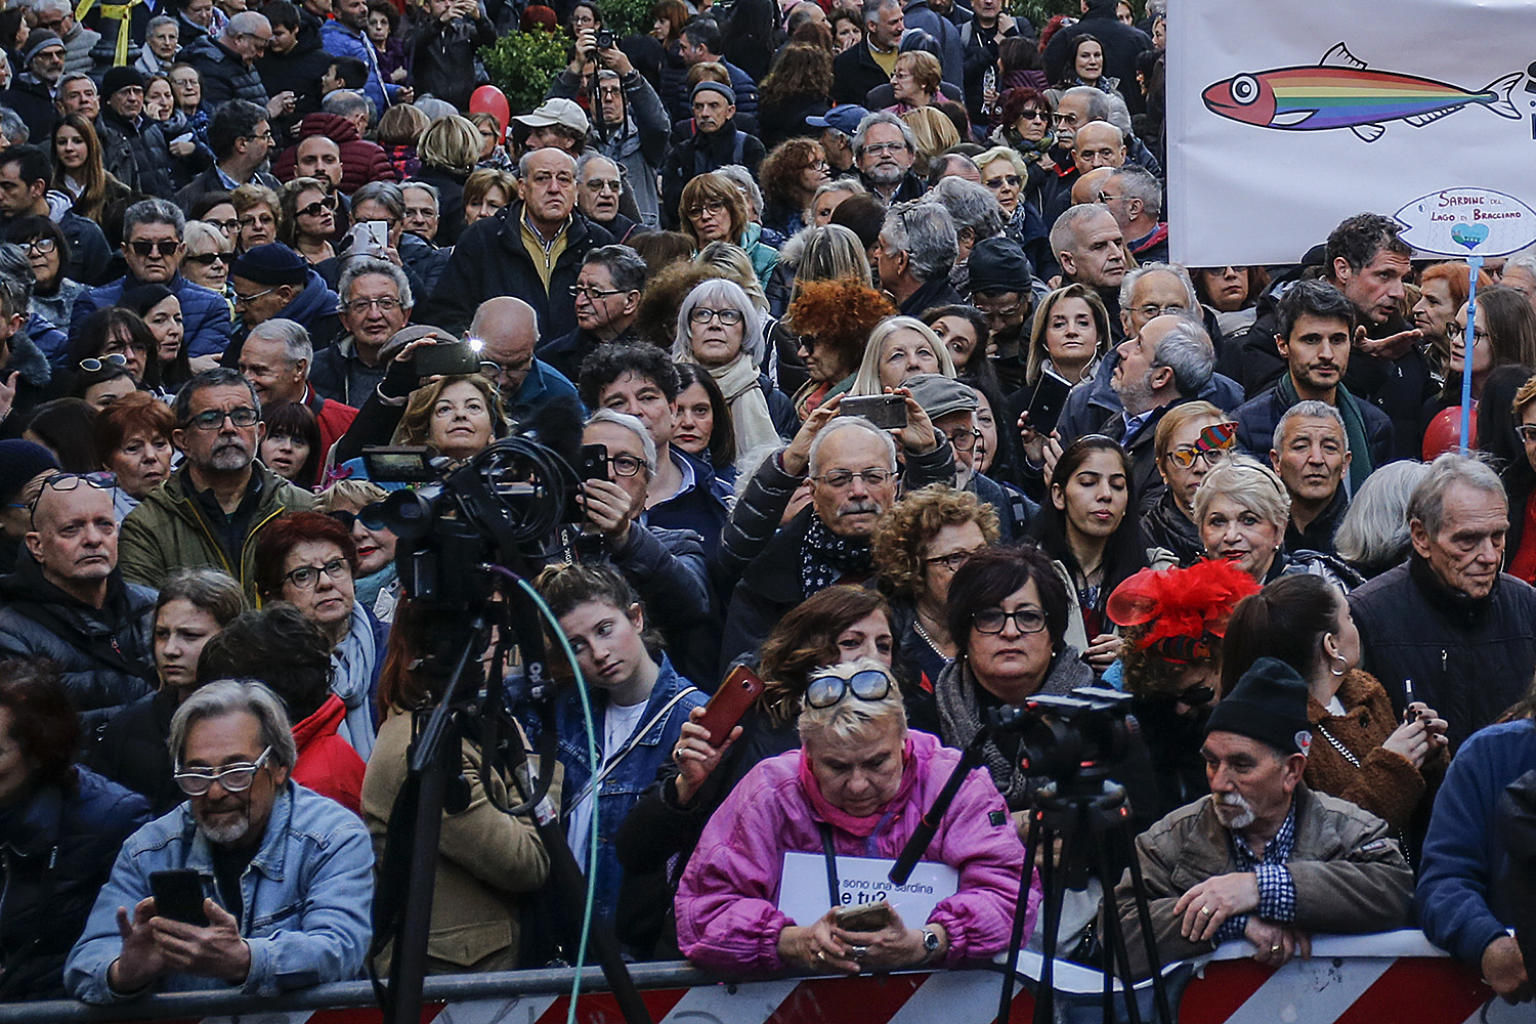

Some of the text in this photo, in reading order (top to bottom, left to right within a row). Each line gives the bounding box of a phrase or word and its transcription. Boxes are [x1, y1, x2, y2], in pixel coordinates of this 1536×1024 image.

[843, 879, 870, 890] sono
[872, 881, 892, 890] una
[841, 891, 887, 906] e tu?
